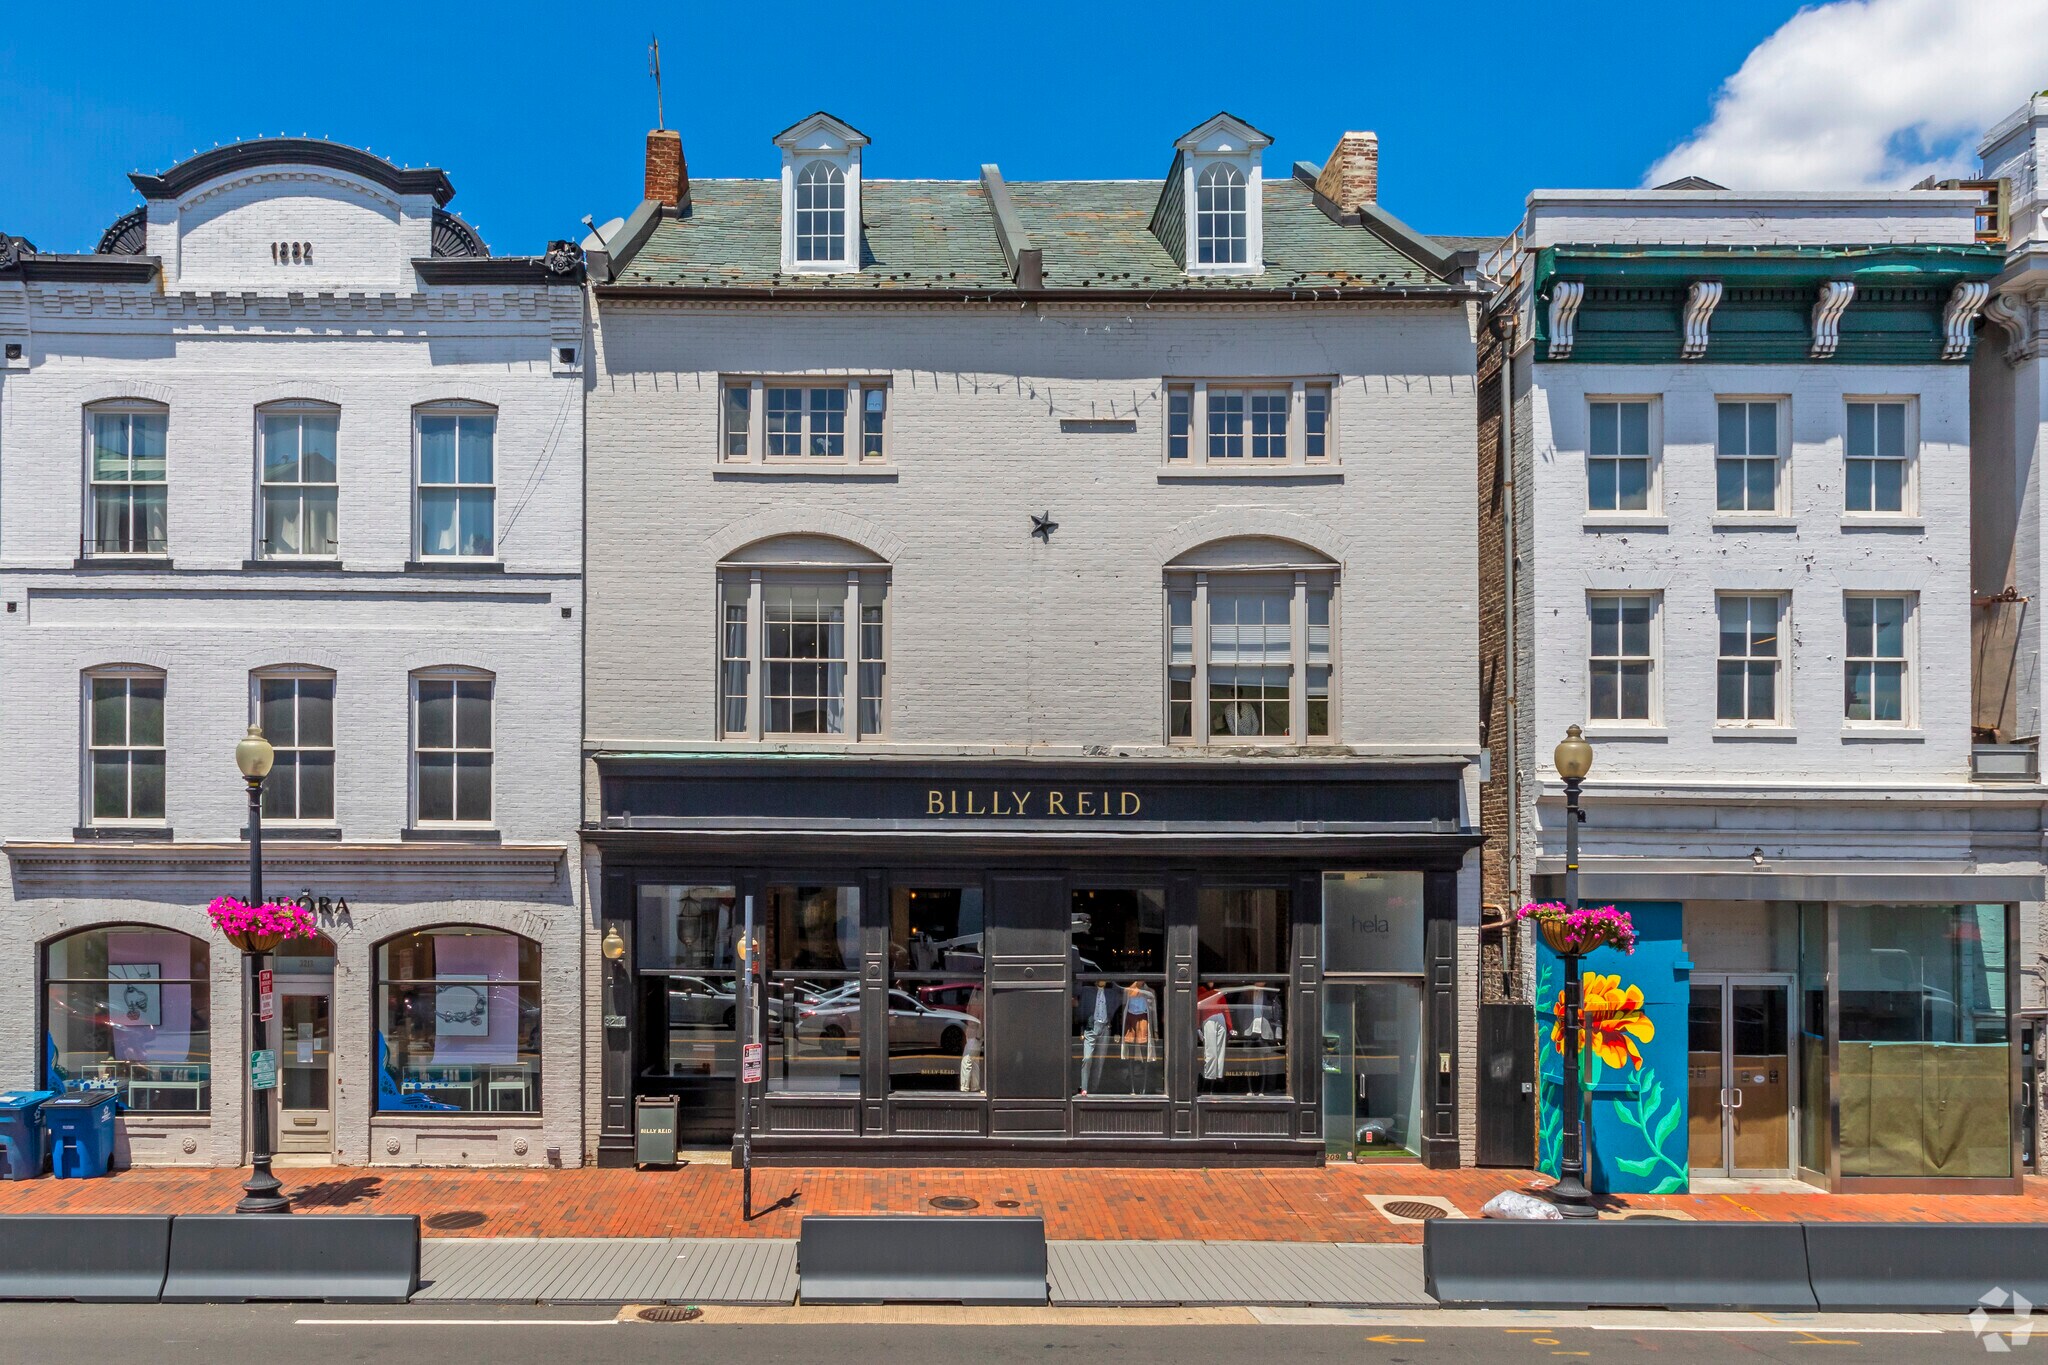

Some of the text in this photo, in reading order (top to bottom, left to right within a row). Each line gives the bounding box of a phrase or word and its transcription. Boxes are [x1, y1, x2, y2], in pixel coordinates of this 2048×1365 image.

[271, 241, 312, 259] 1882
[926, 790, 1141, 816] BILLY REID
[1352, 914, 1389, 933] hela
